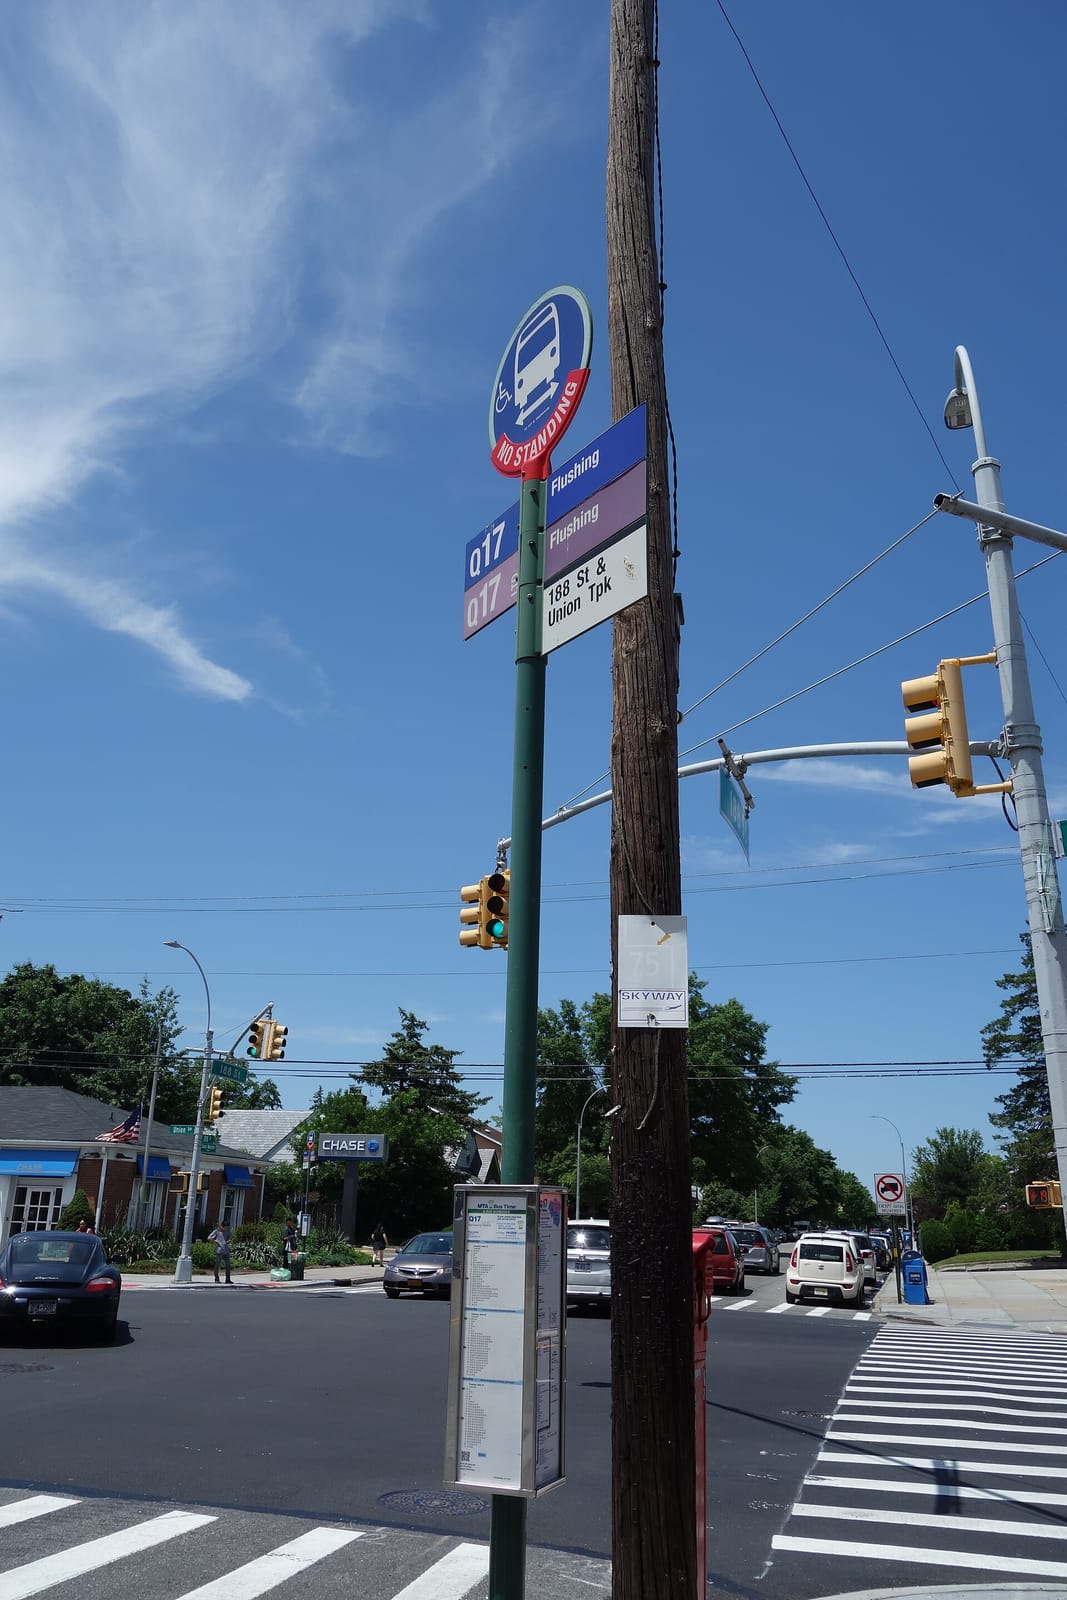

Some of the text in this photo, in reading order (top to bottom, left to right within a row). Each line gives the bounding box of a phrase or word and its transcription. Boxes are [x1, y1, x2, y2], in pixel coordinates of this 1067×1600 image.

[497, 441, 514, 465] NO
[514, 382, 578, 467] STANDING
[551, 449, 600, 497] Flushing
[469, 520, 506, 578] Q17
[550, 503, 599, 550] Flushing
[467, 572, 502, 628] Q17
[548, 574, 613, 627] Union Tpk
[549, 556, 606, 606] 188 St &
[621, 991, 684, 1001] SKYWAY
[220, 1065, 241, 1080] 188 St
[322, 1140, 366, 1151] CHASE
